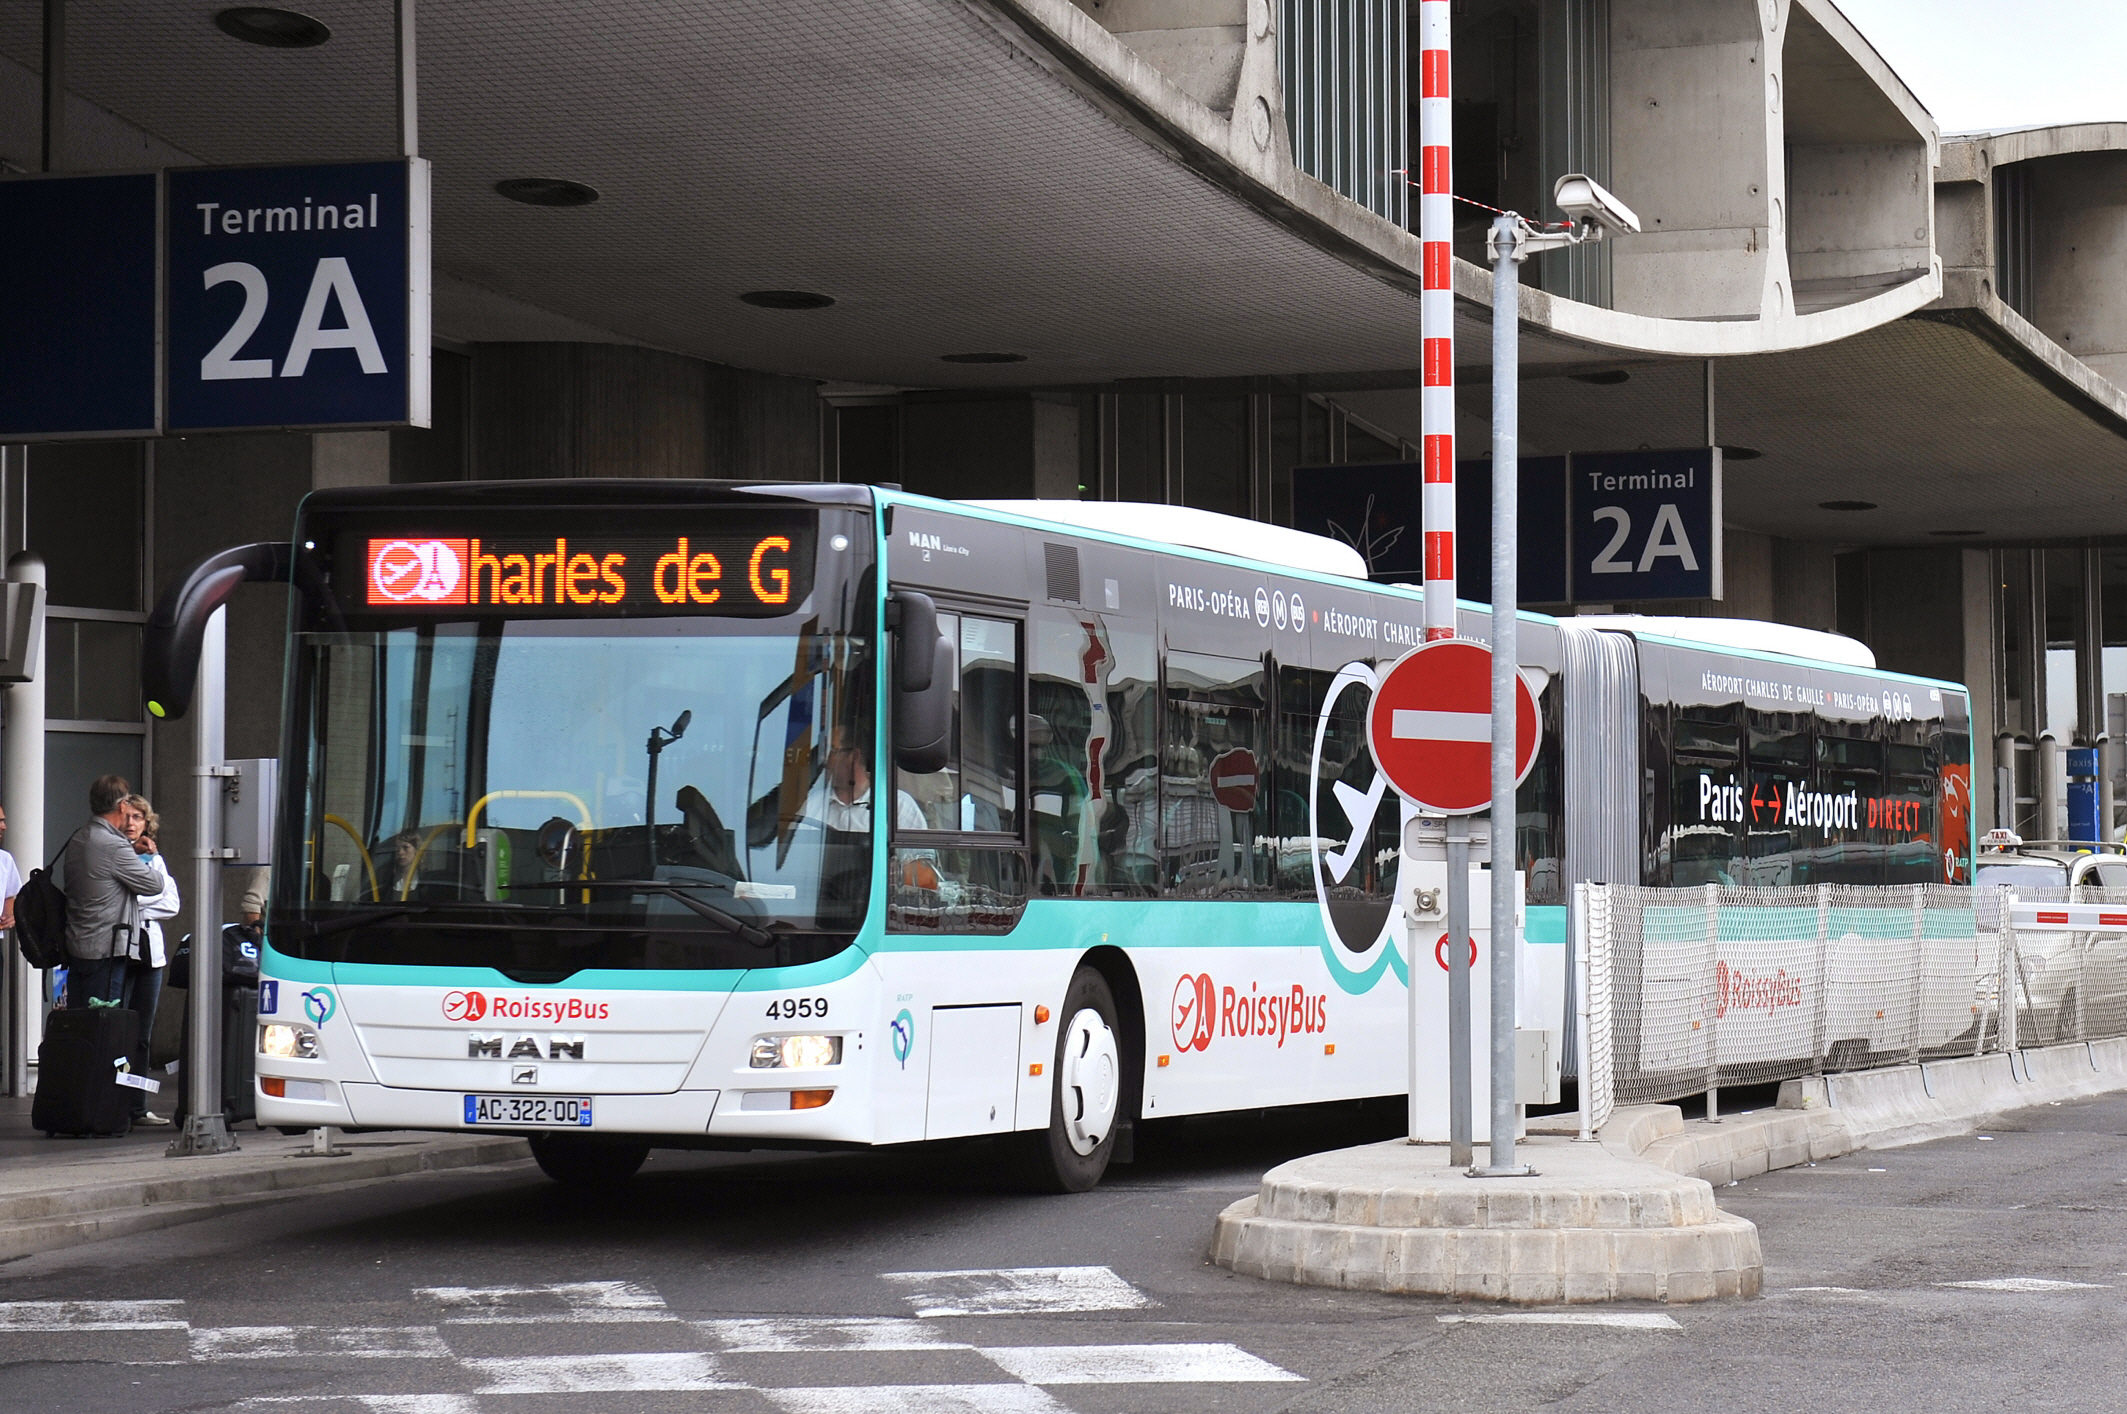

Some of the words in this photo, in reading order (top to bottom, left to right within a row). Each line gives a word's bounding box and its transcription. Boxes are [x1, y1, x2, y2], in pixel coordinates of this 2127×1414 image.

[197, 193, 379, 235] Terminal
[200, 256, 389, 381] 2A
[1589, 468, 1695, 492] Terminal
[909, 531, 941, 551] MAN
[1591, 503, 1700, 575] 2A
[469, 537, 627, 604] harles
[653, 536, 722, 604] de
[748, 536, 790, 604] G
[1169, 583, 1250, 620] PARIS-OPÉRA
[1323, 610, 1378, 640] AÉROPORT
[1383, 621, 1424, 647] CHARLE
[1702, 669, 1743, 695] AÉROPORT
[1745, 679, 1780, 700] CHARLES
[1782, 684, 1794, 702] DE
[1796, 685, 1825, 706] GAULLE
[1833, 691, 1879, 713] PARIS-OPÉRA
[2069, 758, 2092, 768] Taxis
[1699, 773, 1744, 823] Paris
[1784, 779, 1858, 839] Aéroport
[1868, 797, 1921, 833] DIRECT
[1991, 831, 2007, 839] TAXI
[492, 996, 609, 1023] RoissyBus
[765, 997, 829, 1021] 4959
[1221, 980, 1327, 1049] RoissyBus
[468, 1032, 585, 1060] MAN
[579, 1113, 591, 1124] 75
